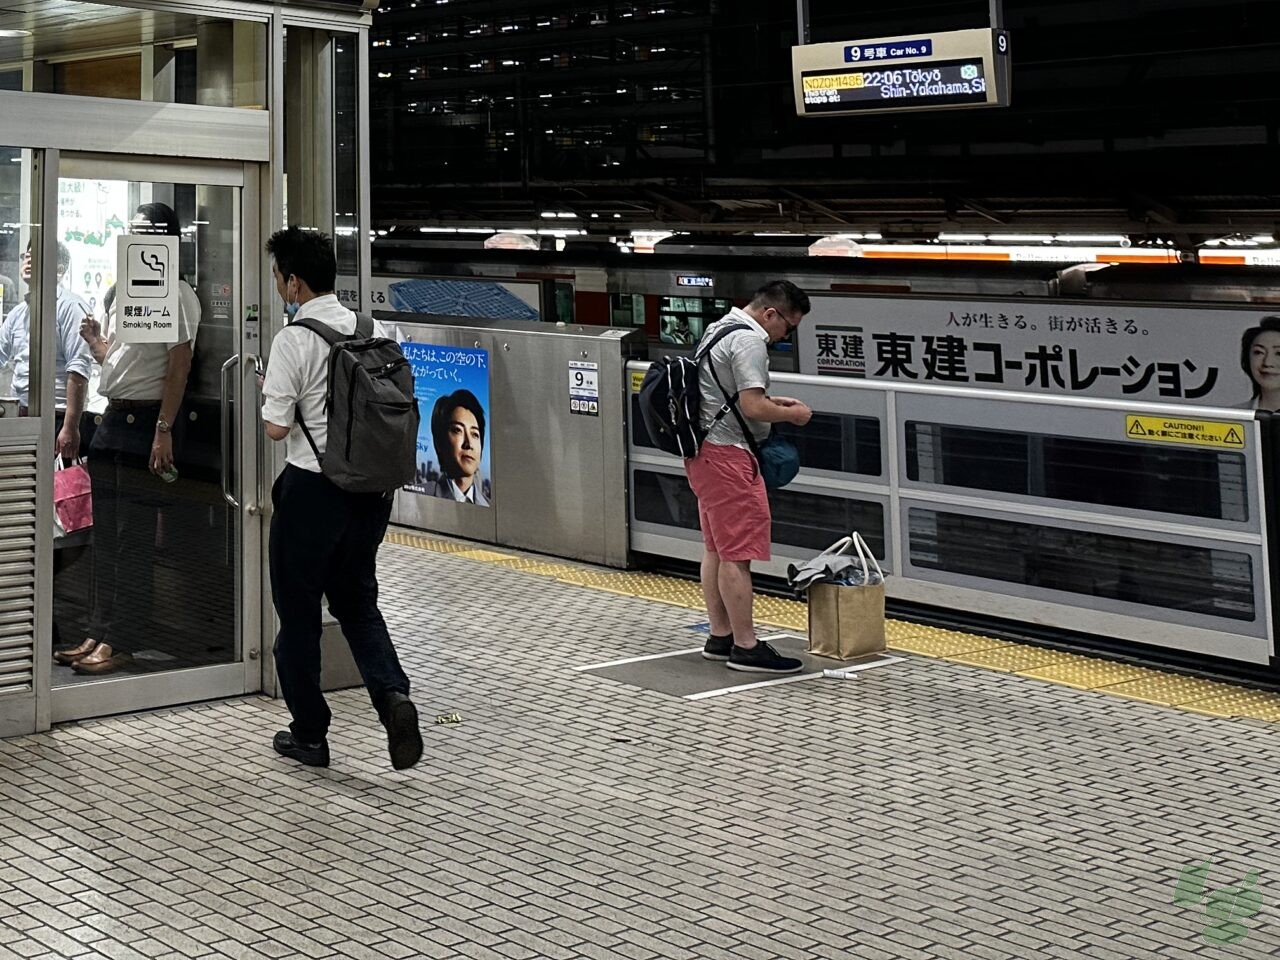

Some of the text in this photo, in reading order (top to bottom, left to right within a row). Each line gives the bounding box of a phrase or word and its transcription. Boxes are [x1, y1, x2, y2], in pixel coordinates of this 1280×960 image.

[890, 48, 904, 57] Car
[905, 46, 919, 55] No.
[920, 45, 927, 54] 9
[998, 35, 1008, 53] 9
[863, 70, 902, 87] 22:06
[124, 305, 170, 318] 喫煙ルーム
[122, 321, 172, 330] Smoking Room
[816, 332, 865, 359] 東建
[816, 357, 866, 369] CORPORATION
[871, 331, 1219, 399] 東建コーポレーション
[575, 371, 584, 387] 9
